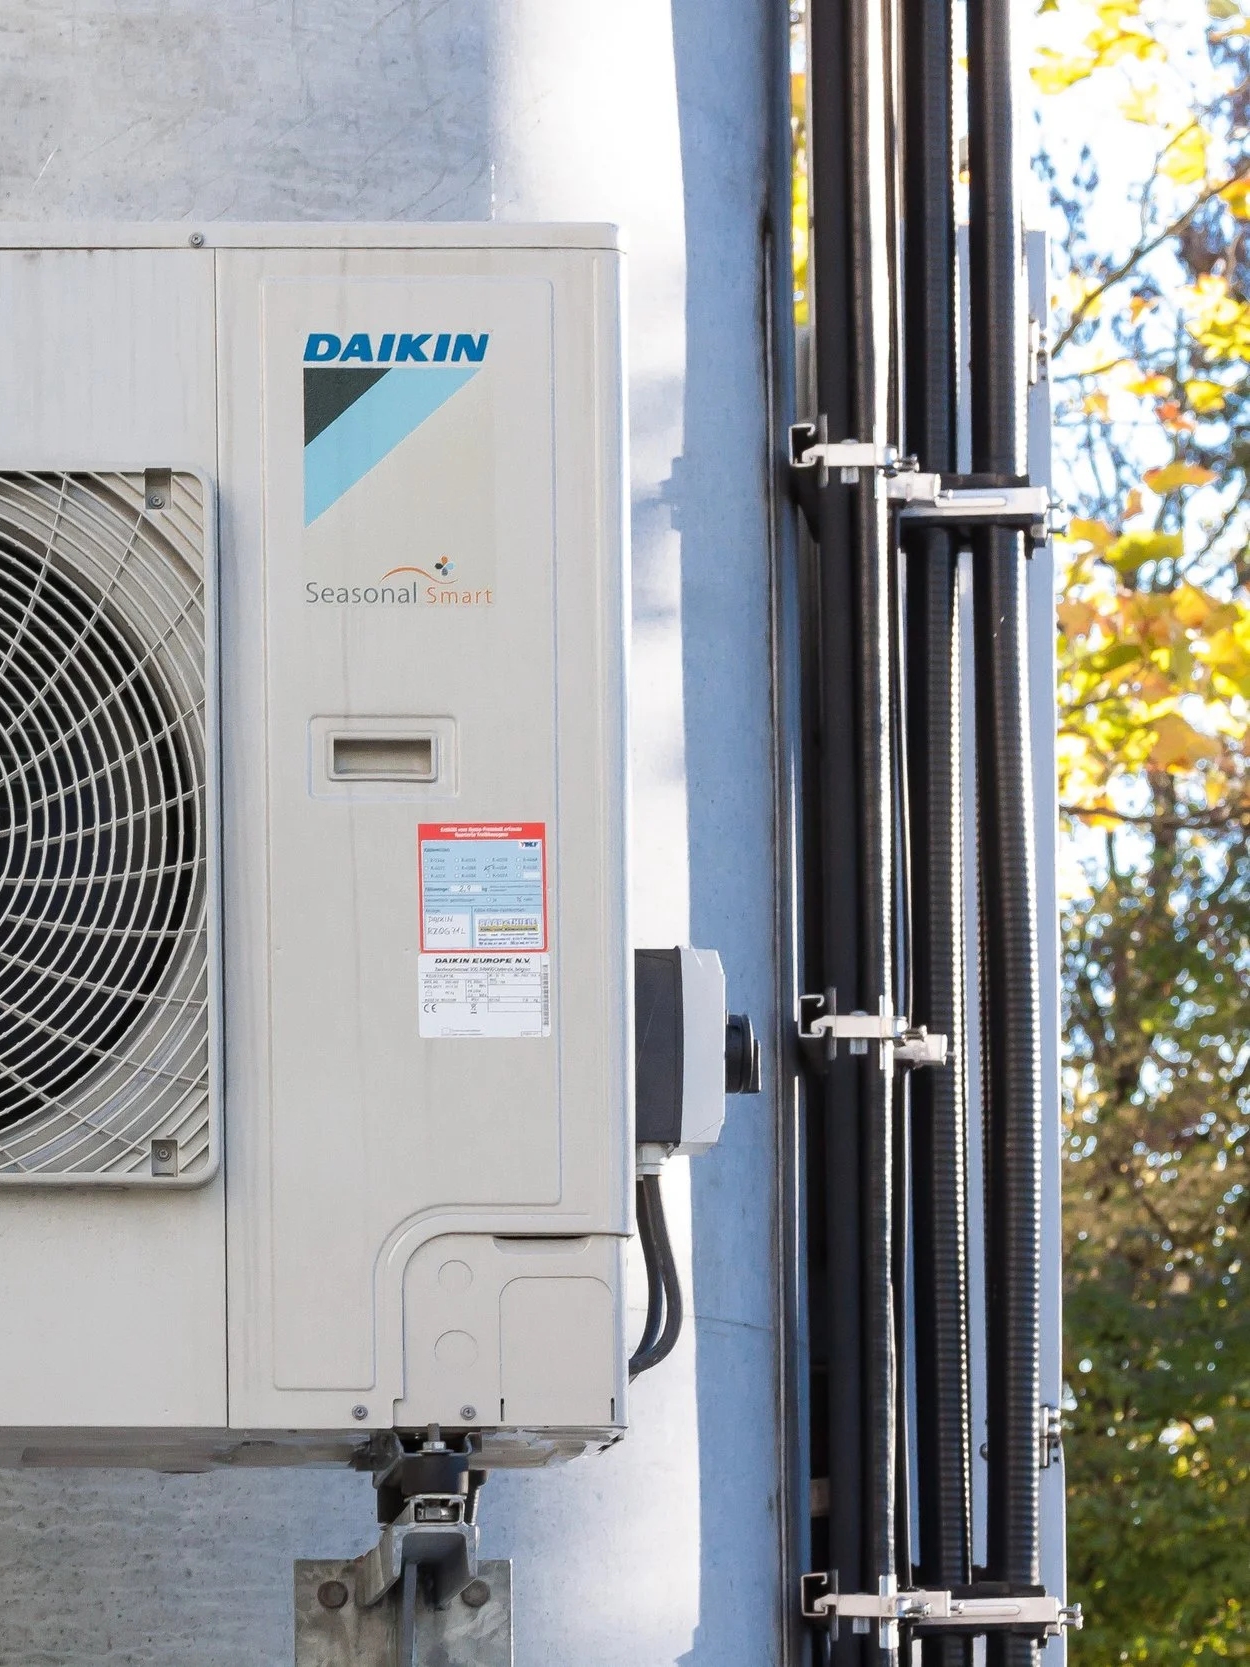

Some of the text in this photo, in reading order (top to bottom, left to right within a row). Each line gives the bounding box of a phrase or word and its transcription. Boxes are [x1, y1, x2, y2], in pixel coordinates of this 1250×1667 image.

[303, 333, 490, 362] DAIKIN
[305, 582, 493, 604] Seasonal Smart
